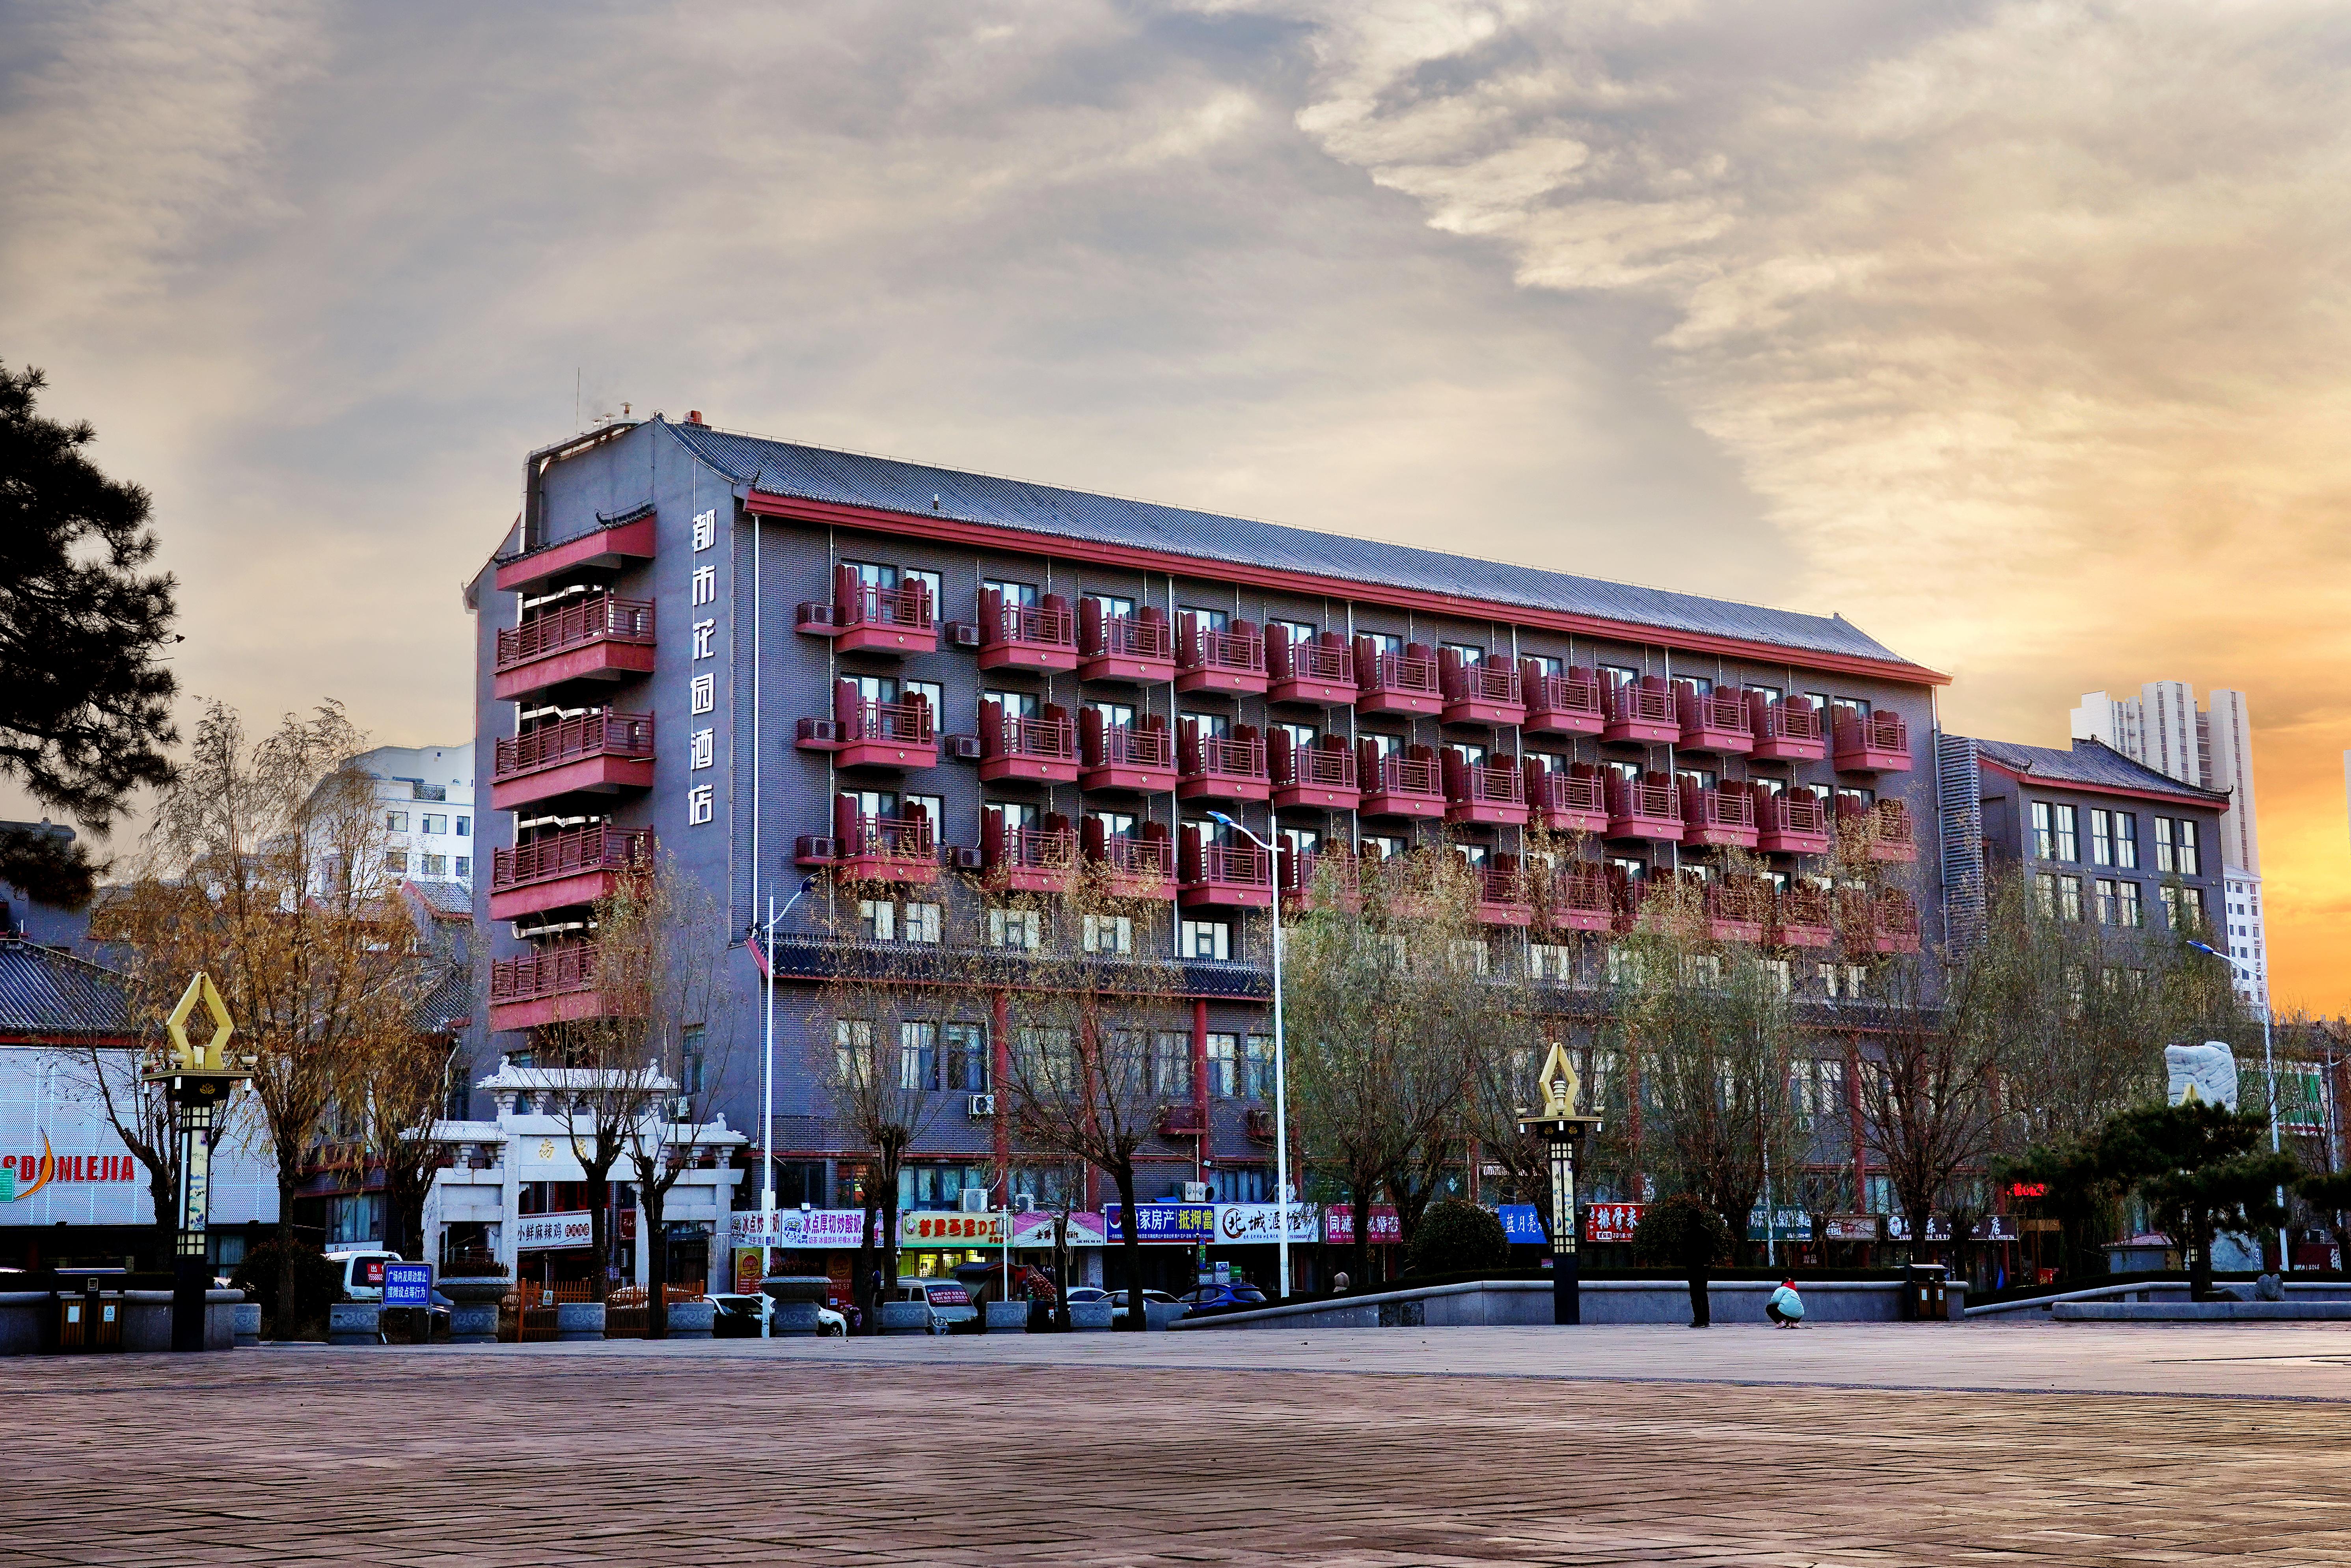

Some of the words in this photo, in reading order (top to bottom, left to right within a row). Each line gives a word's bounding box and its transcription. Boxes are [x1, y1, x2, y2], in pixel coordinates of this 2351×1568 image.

[689, 508, 716, 825] 都市花园酒店
[742, 1213, 779, 1234] 冰点炒奶
[803, 1213, 862, 1235] 冰点厚切炒酸奶
[1135, 1209, 1174, 1230] 家房产
[1330, 1215, 1399, 1233] 同城缘婚恋
[517, 1222, 562, 1242] 小鲜麻辣鸡
[565, 1223, 589, 1237] 民间饭店
[388, 1270, 427, 1283] 广场内及周边禁止
[387, 1286, 426, 1298] 摆摊设点等行为
